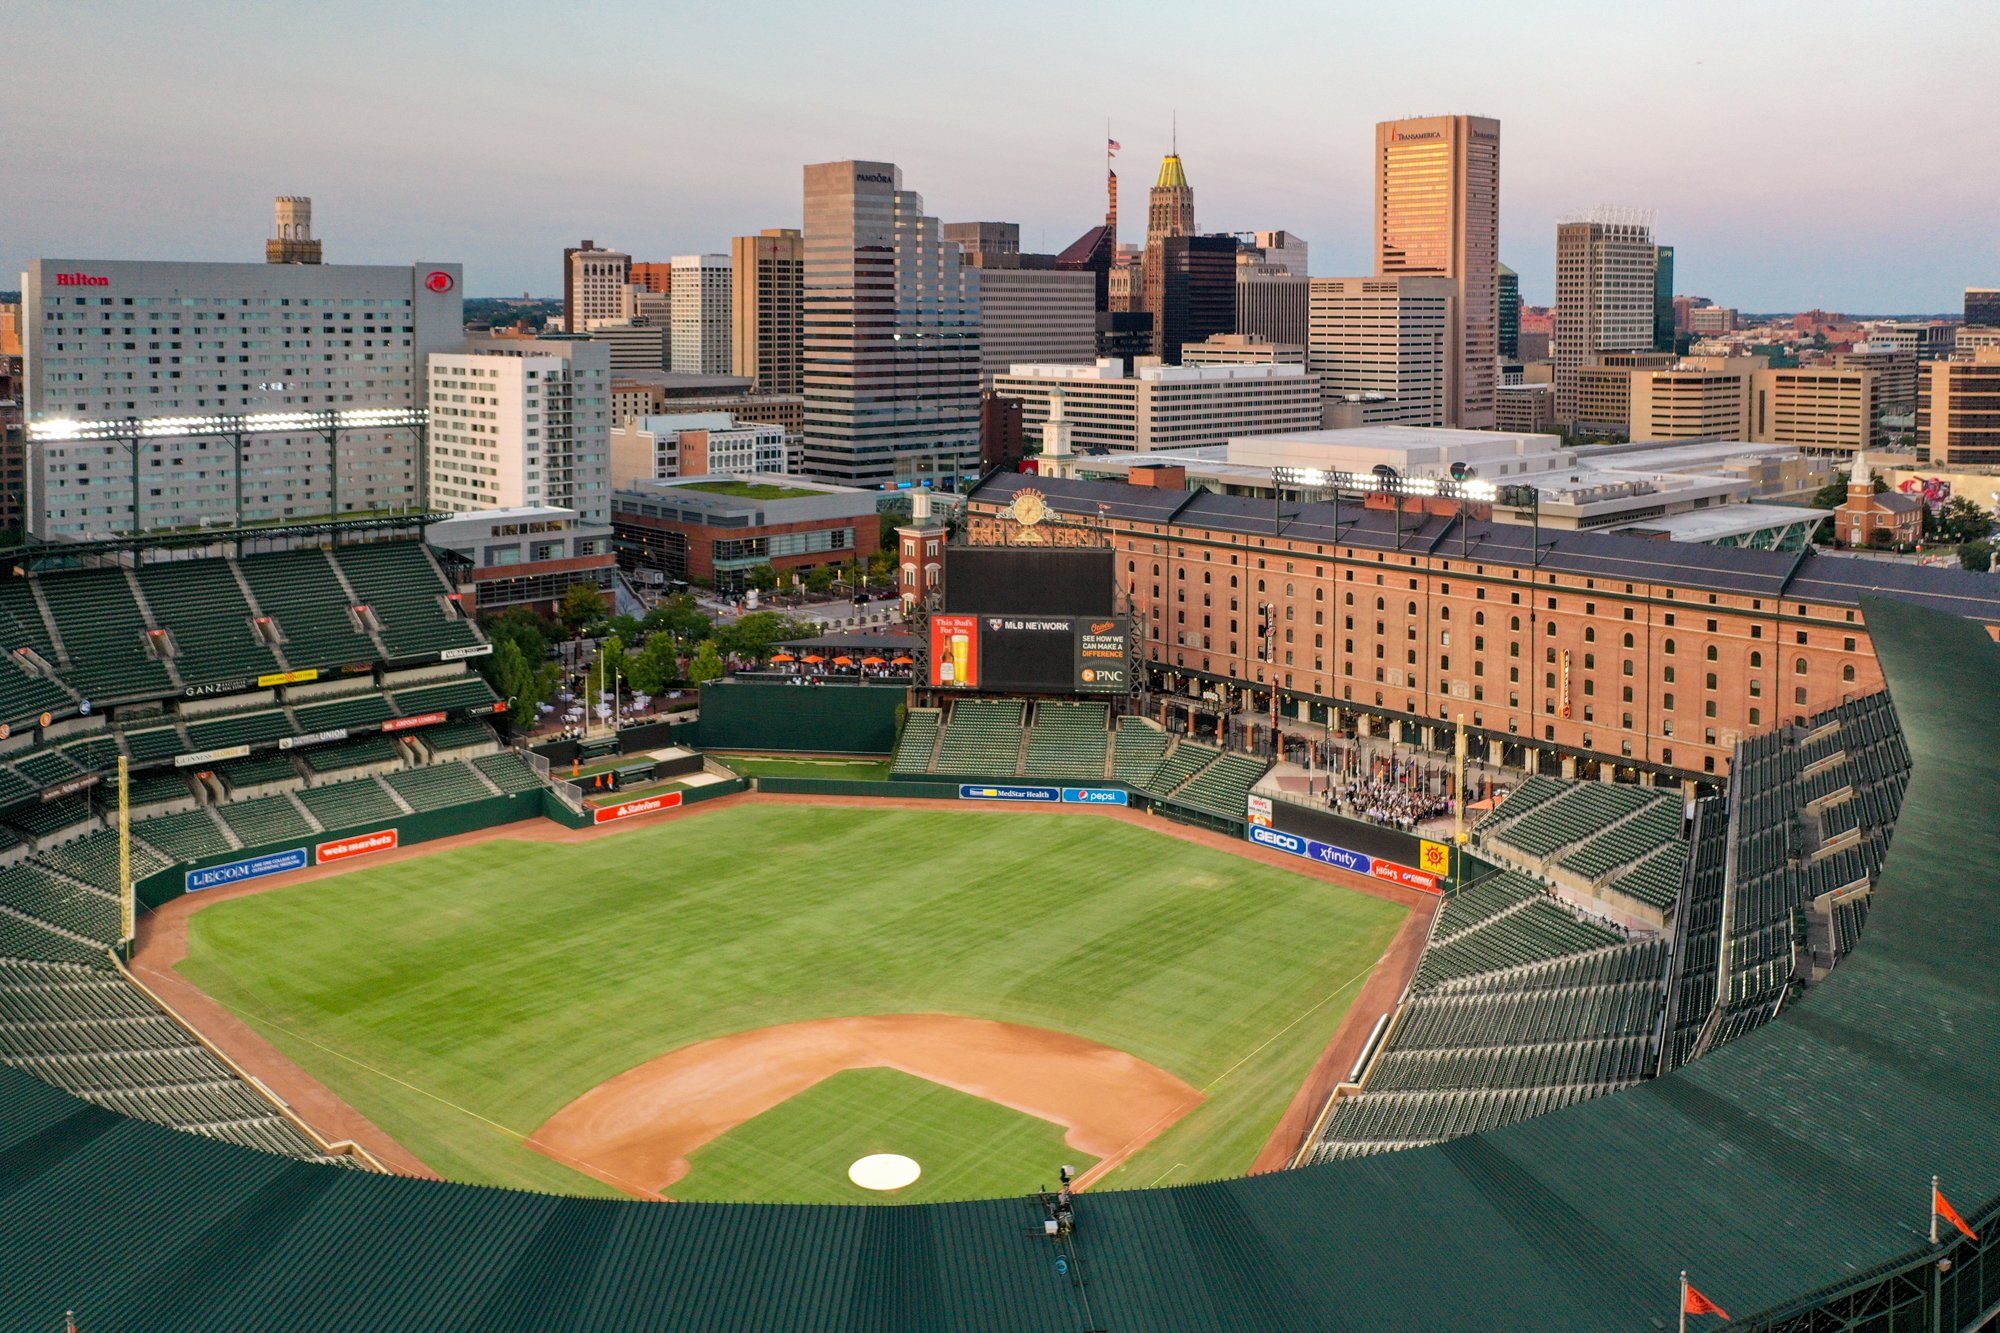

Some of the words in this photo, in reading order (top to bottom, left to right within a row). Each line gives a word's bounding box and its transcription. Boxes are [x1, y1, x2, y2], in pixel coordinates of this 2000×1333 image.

[57, 271, 109, 287] Hilton
[936, 618, 953, 626] This
[954, 618, 973, 627] Bud's
[1004, 621, 1024, 630] MLB
[1025, 621, 1069, 631] NETWORK
[1091, 621, 1116, 634] Orioles
[940, 626, 952, 634] For
[1112, 635, 1124, 643] WE
[1082, 650, 1124, 658] DIFFERENCE
[1096, 670, 1123, 682] PNC
[185, 683, 222, 697] GANZ
[319, 729, 346, 741] UNION
[176, 754, 212, 766] GUINNESS
[997, 790, 1025, 798] MedStar
[1026, 790, 1050, 799] Health
[1090, 792, 1116, 801] pepsi
[1254, 829, 1298, 850] GEICO
[322, 844, 348, 856] weis
[348, 836, 392, 852] markets
[1320, 847, 1357, 868] xfinity
[1375, 865, 1398, 880] HIGH'S
